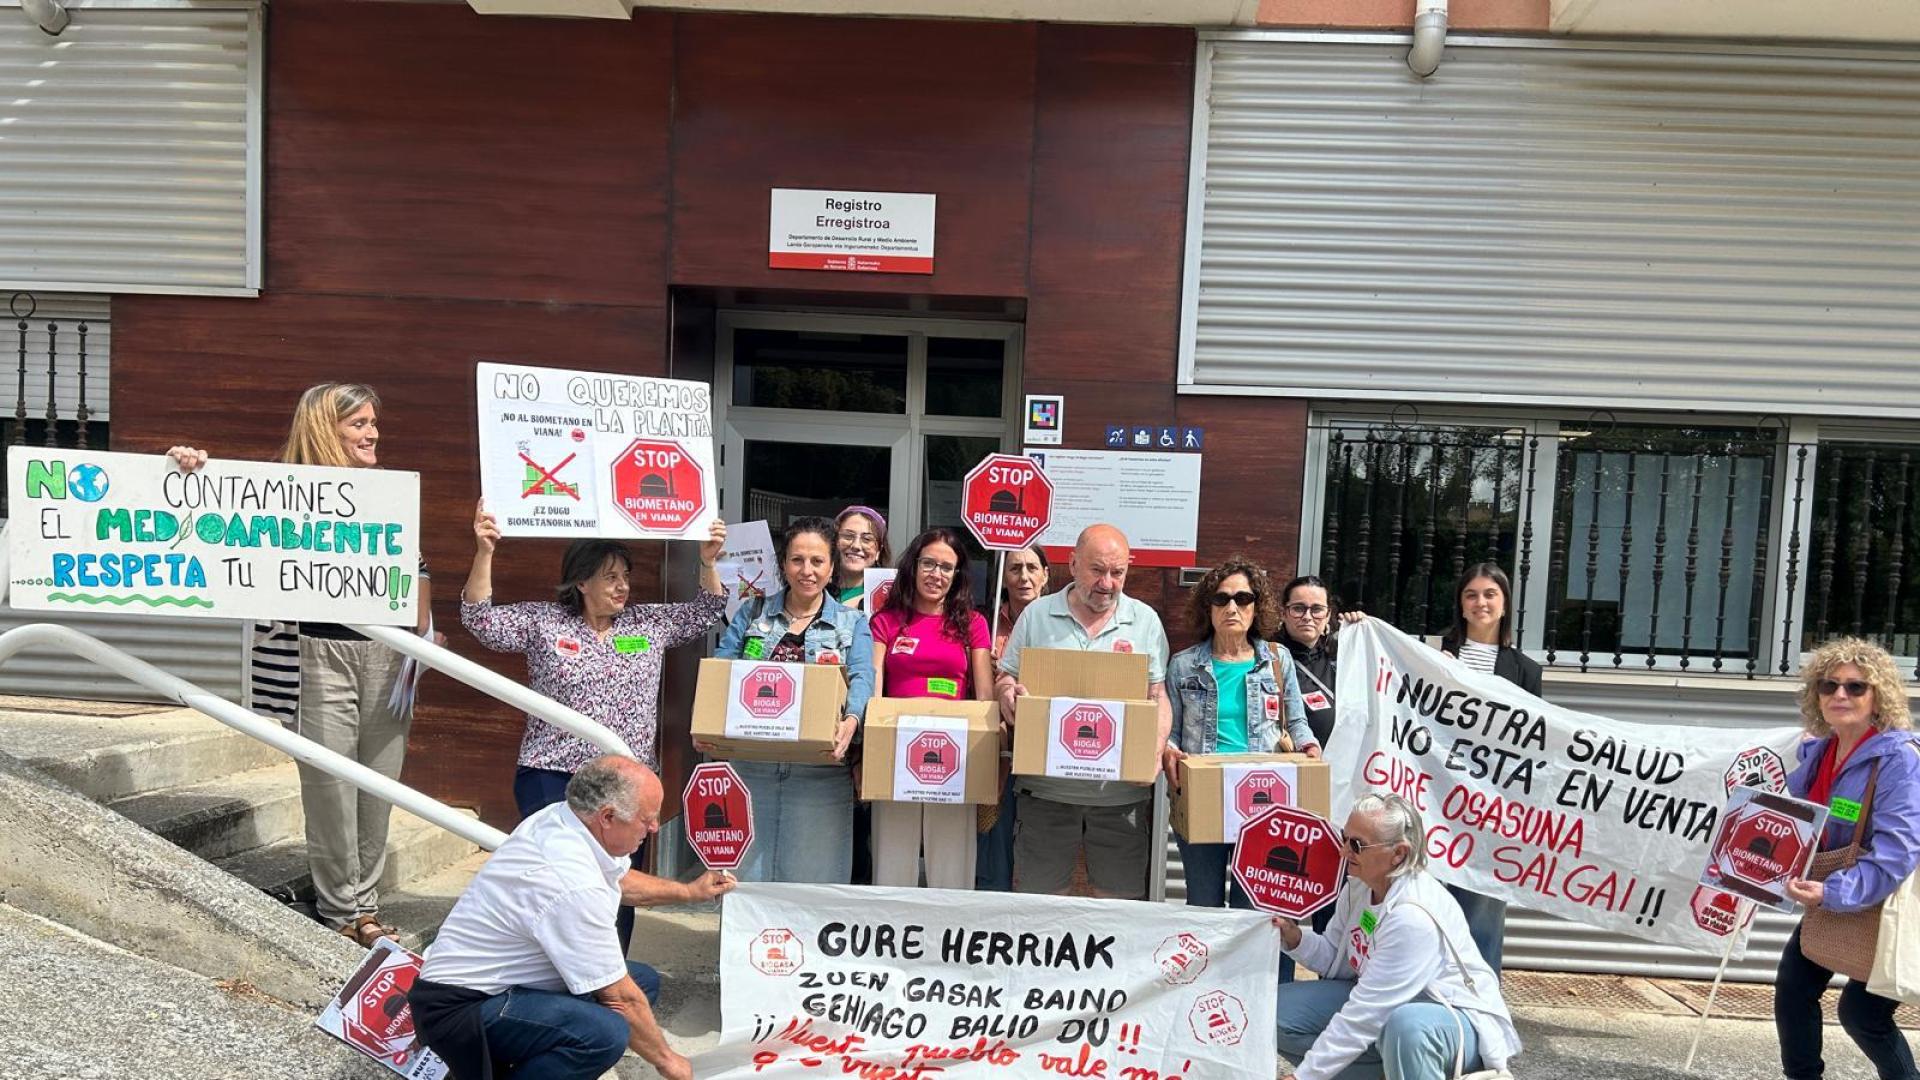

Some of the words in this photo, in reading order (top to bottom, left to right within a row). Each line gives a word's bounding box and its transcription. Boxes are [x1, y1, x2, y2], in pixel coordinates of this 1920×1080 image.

[826, 198, 882, 212] Registro
[816, 215, 890, 230] Erregistroa
[494, 373, 541, 401] NO
[567, 376, 711, 413] QUEREMOS
[518, 414, 529, 423] AL
[531, 414, 580, 427] BIOMETANO
[581, 418, 593, 427] EN
[594, 407, 625, 434] LA
[634, 410, 712, 438] PLANTA
[533, 427, 562, 438] VIANA!
[634, 449, 681, 469] STOP
[988, 466, 1034, 486] STOP
[163, 471, 356, 518] CONTAMINES
[624, 497, 695, 512] BIOMETANO
[547, 506, 570, 516] DUGU
[635, 512, 648, 521] EN
[650, 513, 682, 522] VIANA
[974, 512, 1039, 528] BIOMETANO
[41, 508, 72, 539] EL
[507, 517, 572, 528] BIOMETANORIK
[982, 526, 992, 535] EN
[995, 528, 1025, 538] VIANA
[222, 557, 255, 589] TU
[755, 671, 783, 683] STOP
[1074, 711, 1103, 723] STOP
[921, 737, 948, 748] STOP
[1566, 728, 1685, 785] SALUD
[1738, 752, 1769, 771] STOP
[698, 777, 732, 797] STOP
[1248, 777, 1277, 788] STOP
[1391, 715, 1432, 756] NO
[1556, 769, 1614, 812] EN
[1623, 786, 1718, 844] VENTA
[1248, 805, 1269, 814] BIOG
[1363, 751, 1434, 812] GURE
[1441, 784, 1584, 859] OSASUNA
[695, 829, 744, 842] BIOMETANO
[1268, 817, 1323, 846] STOP
[1755, 817, 1792, 838] STOP
[702, 845, 711, 855] EN
[712, 845, 735, 855] VIANA
[1732, 847, 1783, 873] BIOMETANO
[1245, 866, 1324, 896] BIOMETANO
[1253, 883, 1266, 894] EN
[1270, 888, 1304, 906] VIANA
[762, 934, 791, 944] STOP
[817, 922, 924, 960] GURE
[941, 927, 1116, 971] HERRIAK
[1178, 937, 1205, 957] STOP
[364, 971, 396, 1008] STOP
[798, 971, 890, 992] ZUEN
[904, 977, 1003, 1008] GASAK
[1023, 988, 1128, 1013] BAINO
[1198, 995, 1225, 1013] STOP
[802, 993, 927, 1039] GEHIAGO
[948, 1014, 1039, 1040] BALIO
[1037, 1043, 1109, 1079] vale
